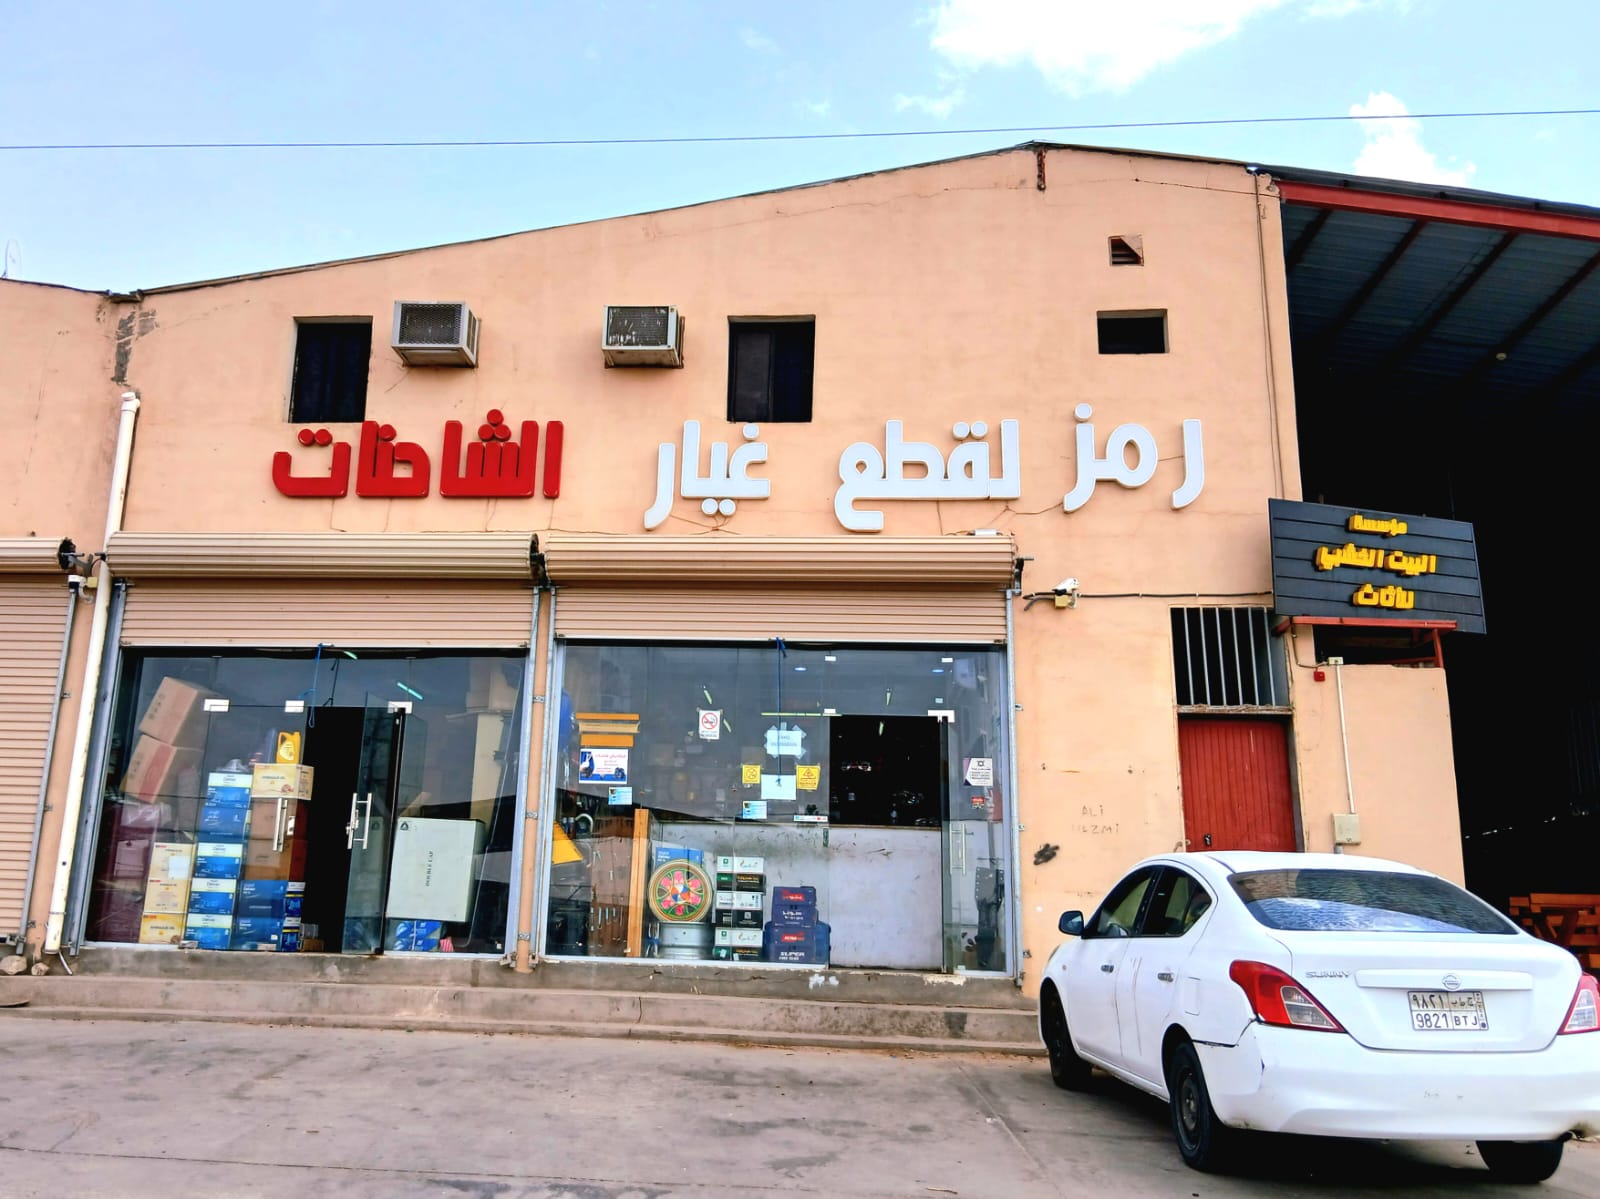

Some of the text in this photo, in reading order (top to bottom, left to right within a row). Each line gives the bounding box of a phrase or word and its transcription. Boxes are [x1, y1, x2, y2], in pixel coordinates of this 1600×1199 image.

[272, 402, 1206, 532] رمز لقطع غيار الشاحنات
[1416, 1013, 1449, 1028] 9821
